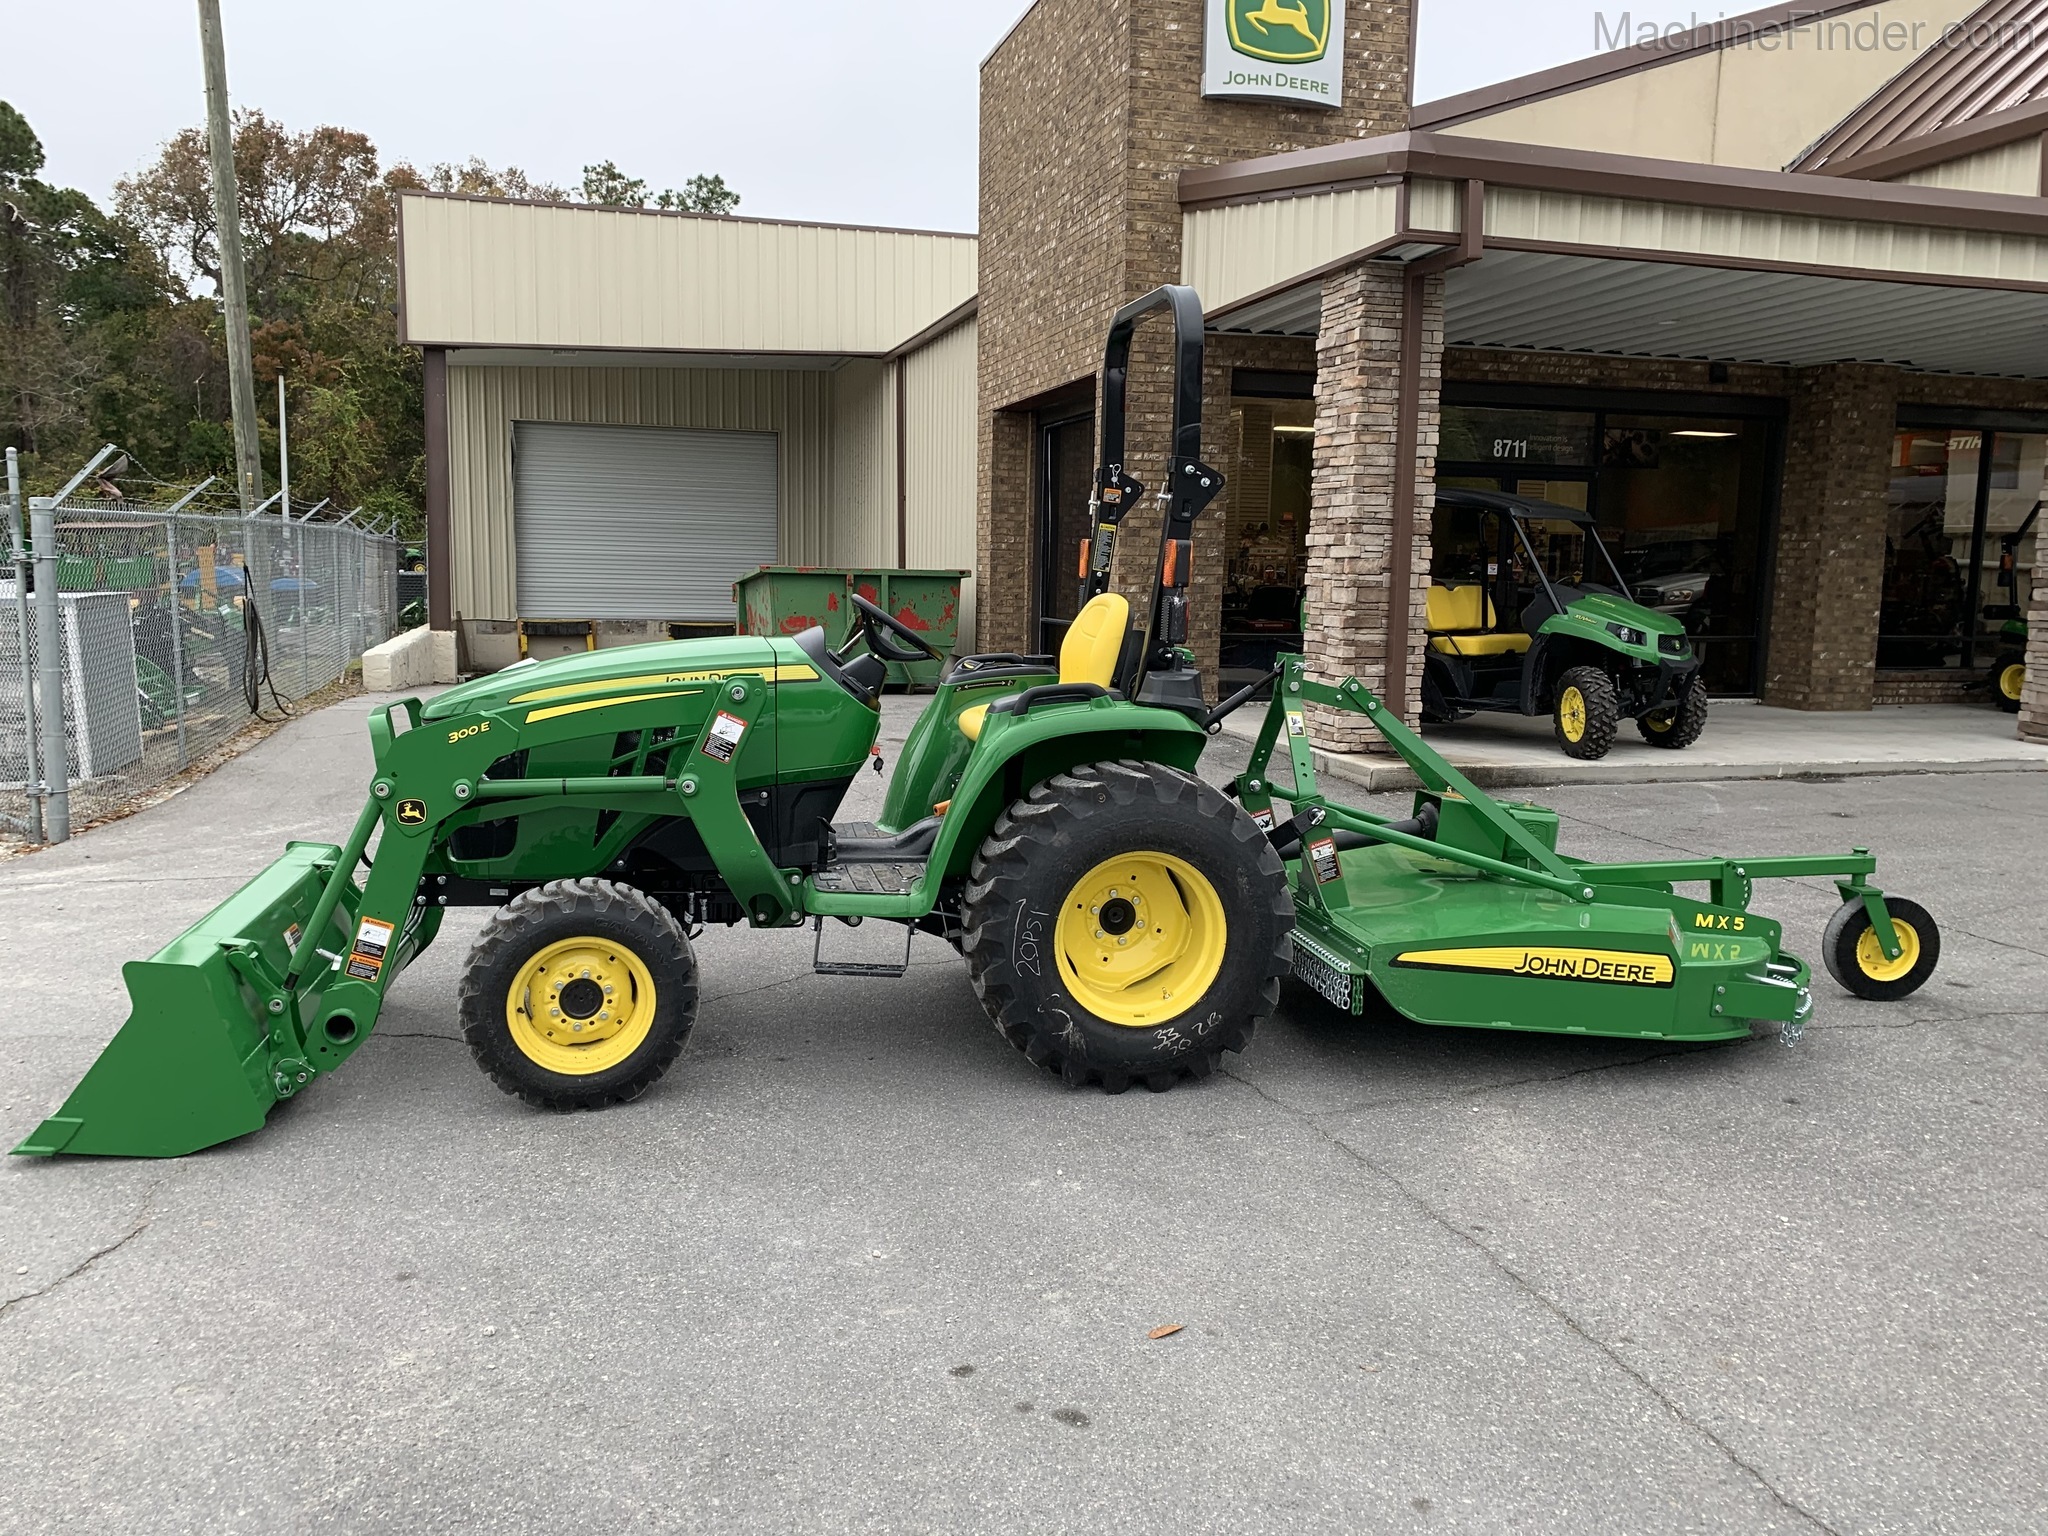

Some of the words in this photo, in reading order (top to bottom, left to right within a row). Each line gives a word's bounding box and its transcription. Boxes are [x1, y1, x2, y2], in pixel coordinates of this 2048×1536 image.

[1222, 70, 1272, 86] JOHN
[1275, 72, 1329, 95] DEERE
[1493, 438, 1527, 458] 8711
[1514, 952, 1577, 976] JOHN
[1582, 957, 1656, 981] DEERE
